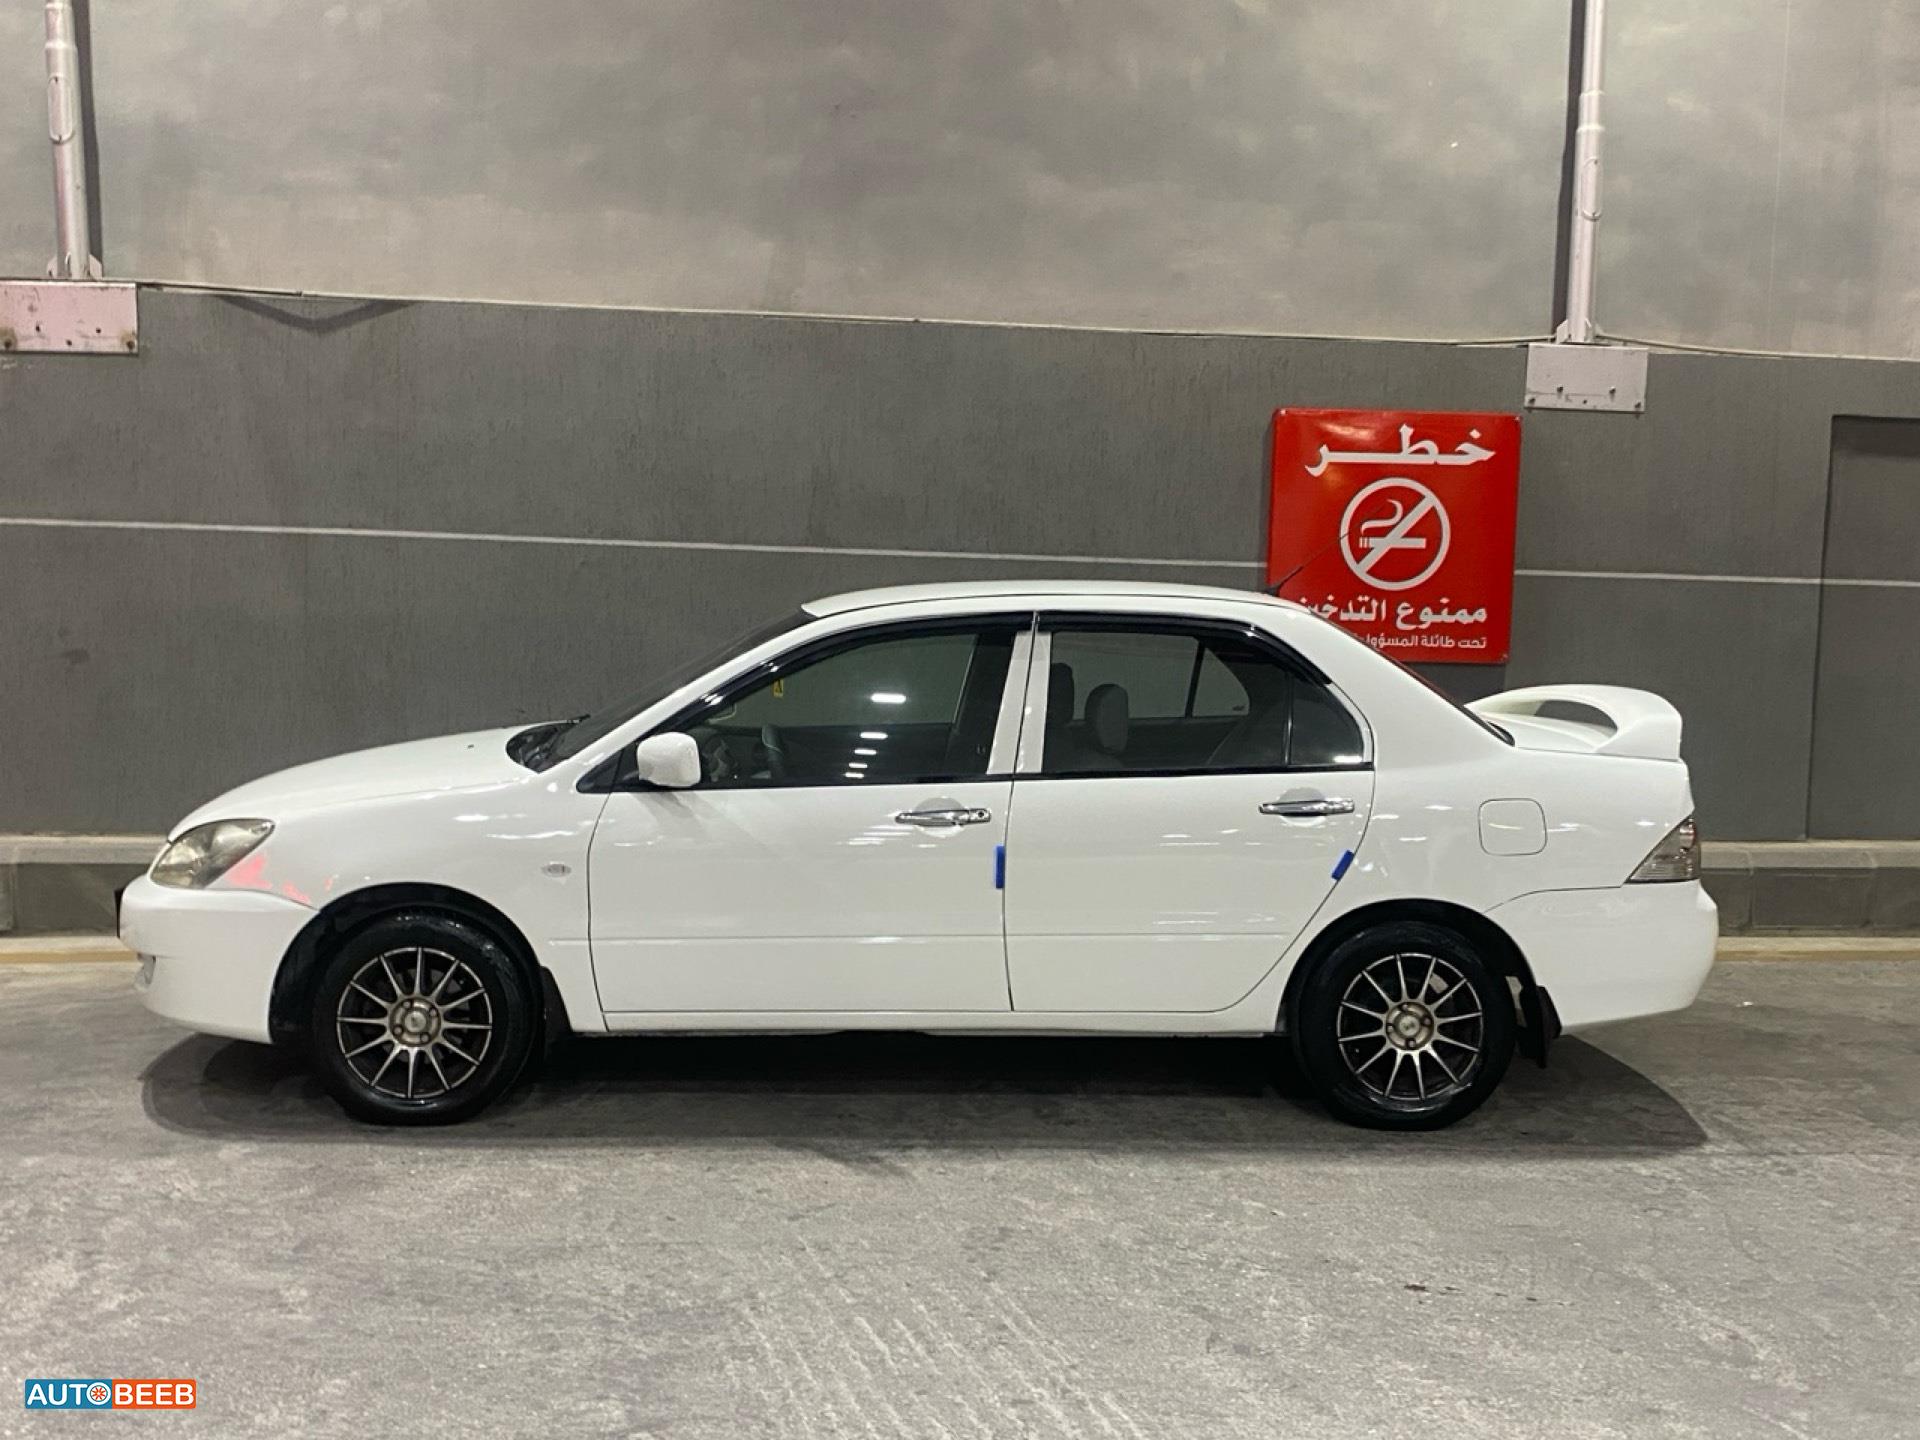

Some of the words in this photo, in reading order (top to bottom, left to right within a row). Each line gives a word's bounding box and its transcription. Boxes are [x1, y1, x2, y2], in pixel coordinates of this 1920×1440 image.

[1304, 423, 1496, 477] خطر
[1396, 597, 1488, 630] ممنوع
[1366, 632, 1418, 648] المسؤول
[1421, 634, 1455, 648] طائلة
[1458, 637, 1487, 649] تحت
